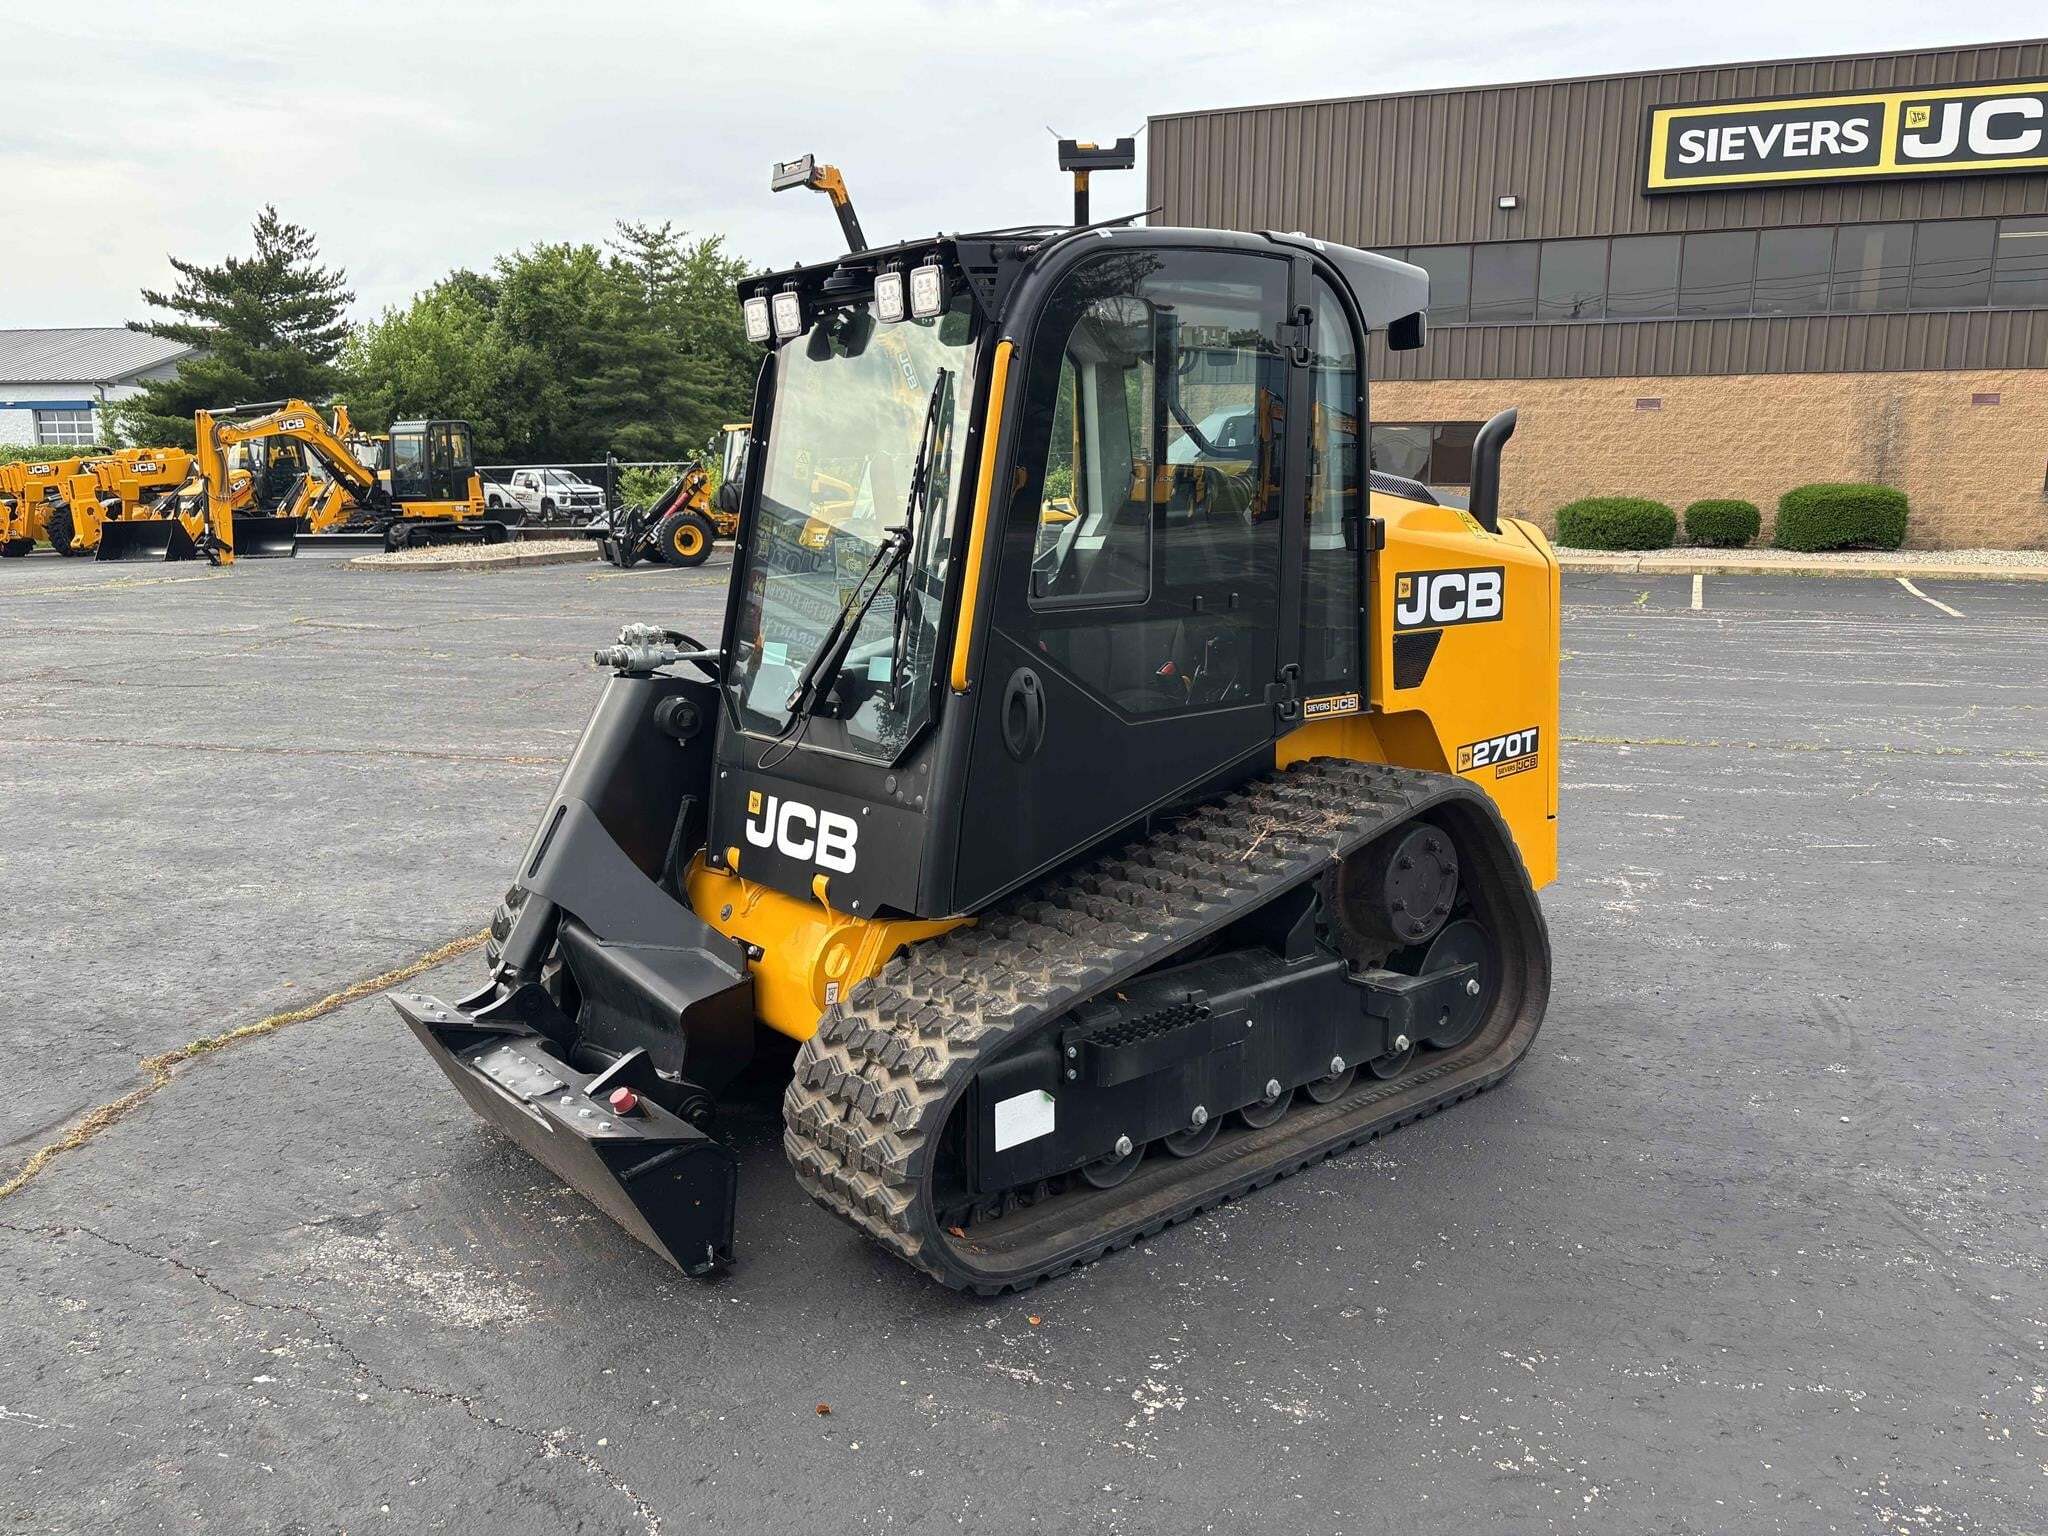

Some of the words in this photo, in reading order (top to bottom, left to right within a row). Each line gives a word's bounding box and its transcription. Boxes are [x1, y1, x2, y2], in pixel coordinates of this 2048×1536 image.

[1678, 117, 1870, 164] SIEVERS
[1903, 97, 2044, 158] JC
[279, 419, 304, 430] JCB
[28, 464, 50, 475] JCB
[131, 463, 156, 473] JCB
[231, 479, 247, 491] CB
[1398, 572, 1501, 625] JCB
[1307, 702, 1330, 713] SIEVERS
[1333, 697, 1356, 710] JCB
[1473, 728, 1537, 767] 270T
[1517, 757, 1536, 770] JCB
[746, 795, 858, 873] JCB
